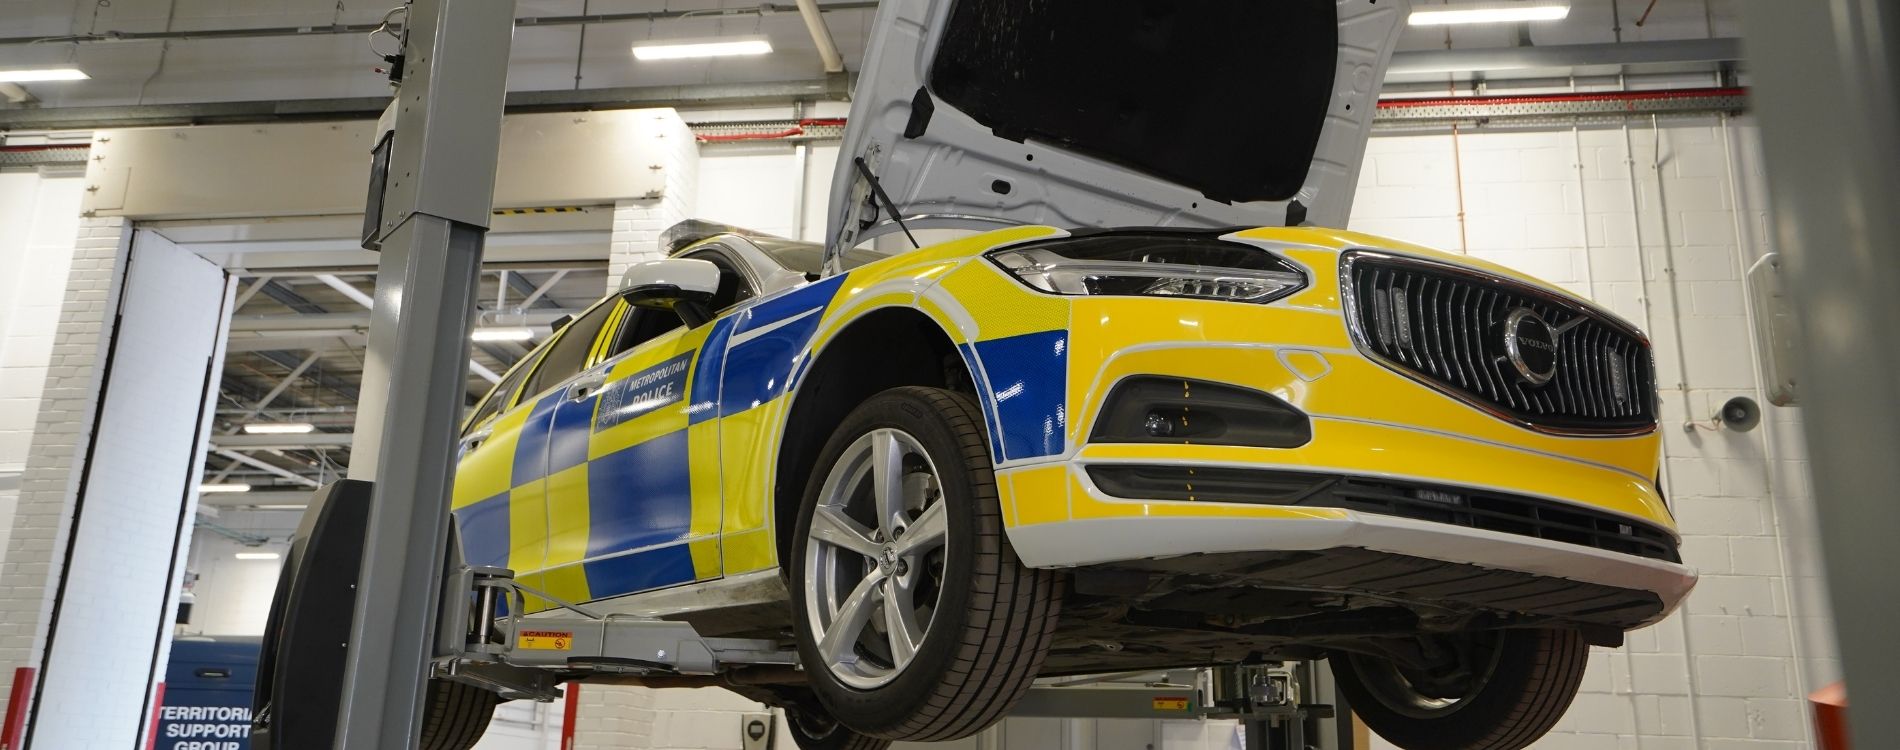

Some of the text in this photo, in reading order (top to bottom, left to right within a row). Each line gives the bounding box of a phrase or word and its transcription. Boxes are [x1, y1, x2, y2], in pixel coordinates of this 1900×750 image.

[1519, 336, 1554, 352] VOLVO
[629, 360, 687, 392] METROPOLITAN
[633, 381, 674, 405] POLICE
[166, 723, 252, 738] SUPPORT
[173, 741, 240, 750] GROUP
